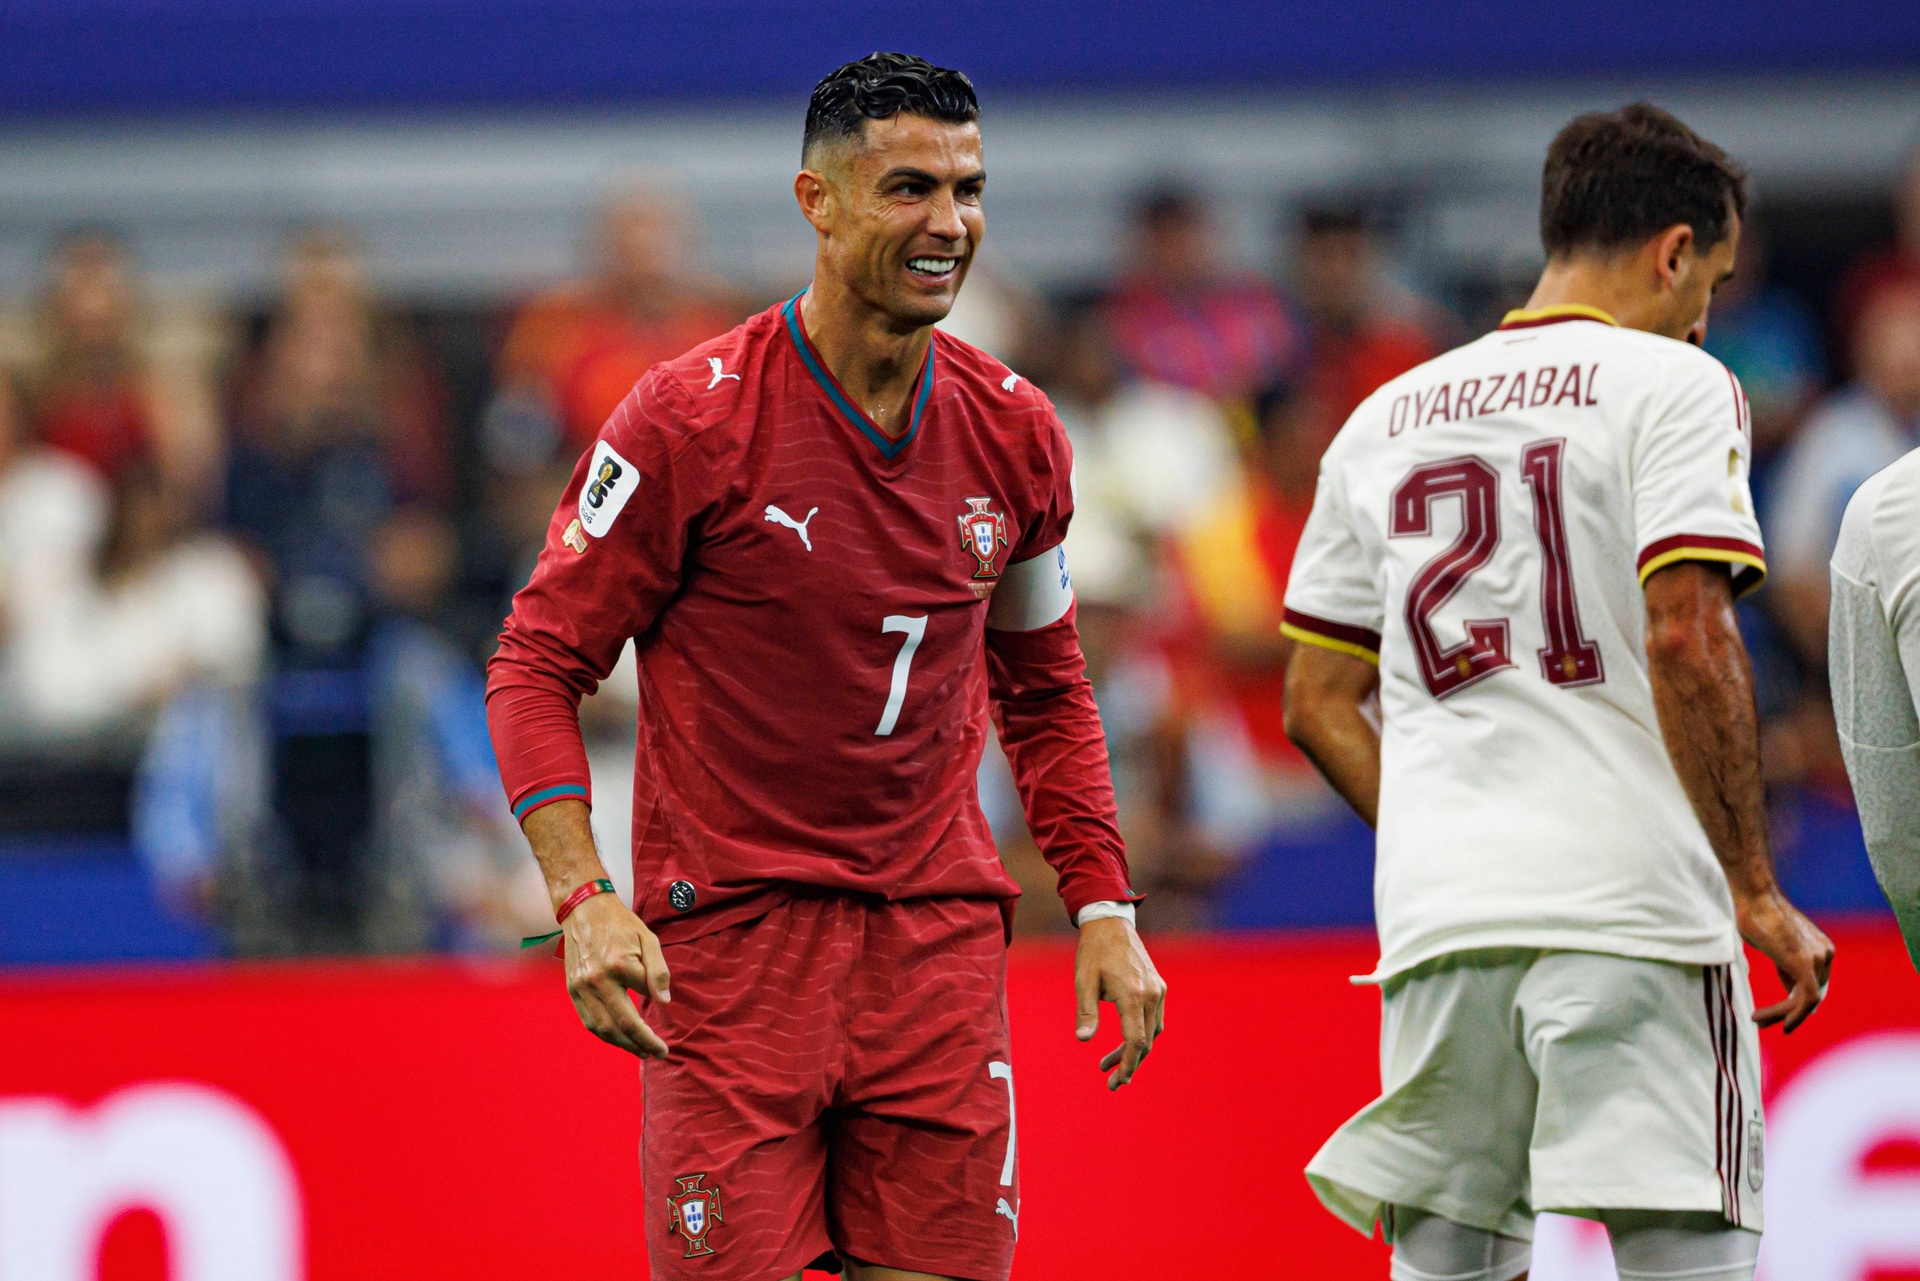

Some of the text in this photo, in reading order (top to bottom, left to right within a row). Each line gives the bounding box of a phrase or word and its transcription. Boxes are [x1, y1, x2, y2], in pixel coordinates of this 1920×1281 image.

[1389, 363, 1599, 437] OYARZABAL
[1388, 437, 1605, 701] 21
[874, 614, 928, 736] 7
[988, 1060, 1016, 1187] 7
